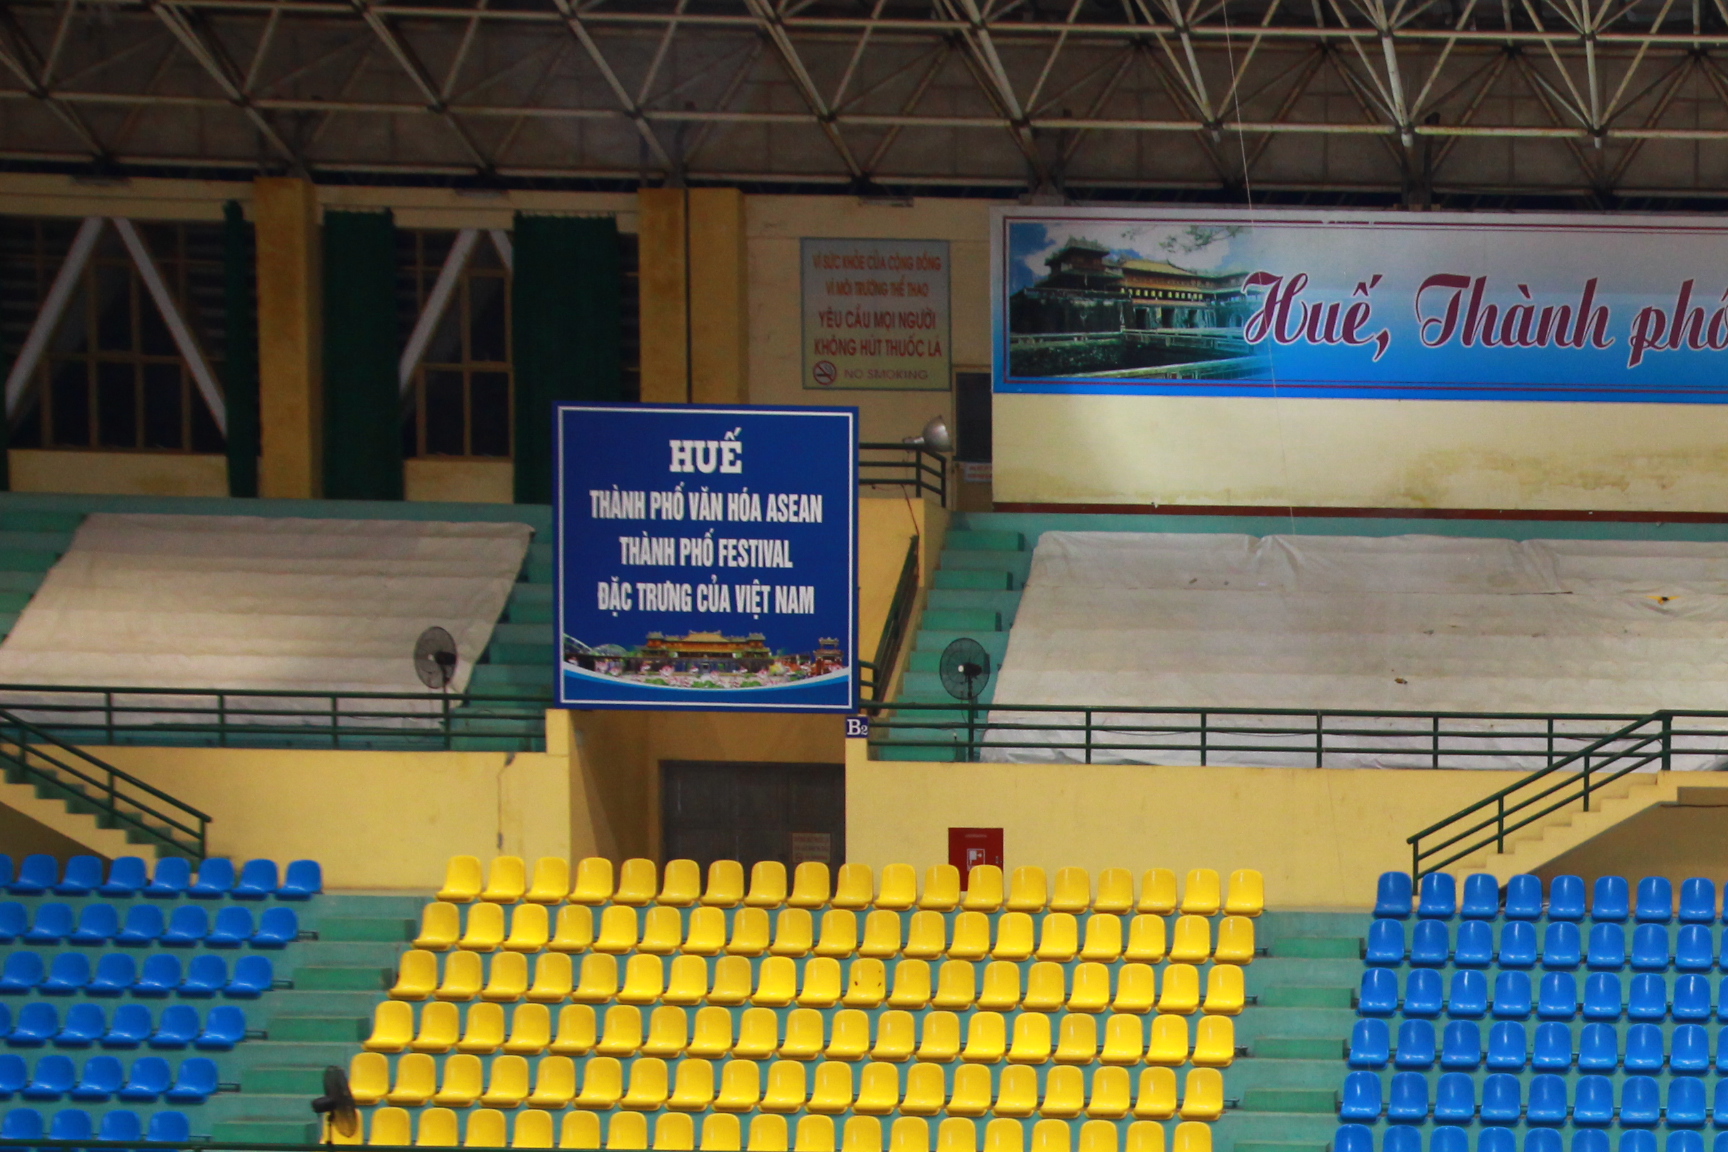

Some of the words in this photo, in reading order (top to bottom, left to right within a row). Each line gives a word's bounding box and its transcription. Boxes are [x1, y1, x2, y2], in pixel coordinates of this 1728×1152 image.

[1241, 272, 1391, 361] Huế,
[1415, 274, 1613, 350] Thành
[814, 336, 856, 356] KHÔNG
[861, 335, 882, 356] HÚT
[887, 333, 924, 357] THUỐC
[928, 336, 941, 356] LÁ
[844, 369, 862, 378] NO
[868, 370, 928, 379] SMOKING
[669, 427, 742, 474] HUẾ
[590, 484, 646, 519] THÀNH
[650, 482, 685, 521] PHỐ
[688, 486, 723, 521] VĂN
[728, 487, 762, 522] HÓA
[766, 494, 822, 523] ASEAN
[619, 531, 675, 566] THÀNH
[679, 528, 714, 567] PHỐ
[718, 539, 793, 568] FESTIVAL
[597, 576, 632, 616] ĐẶC
[636, 582, 692, 612] TRƯNG
[697, 574, 730, 613] CỦA
[735, 579, 770, 619] VIỆT
[775, 585, 814, 614] NAM
